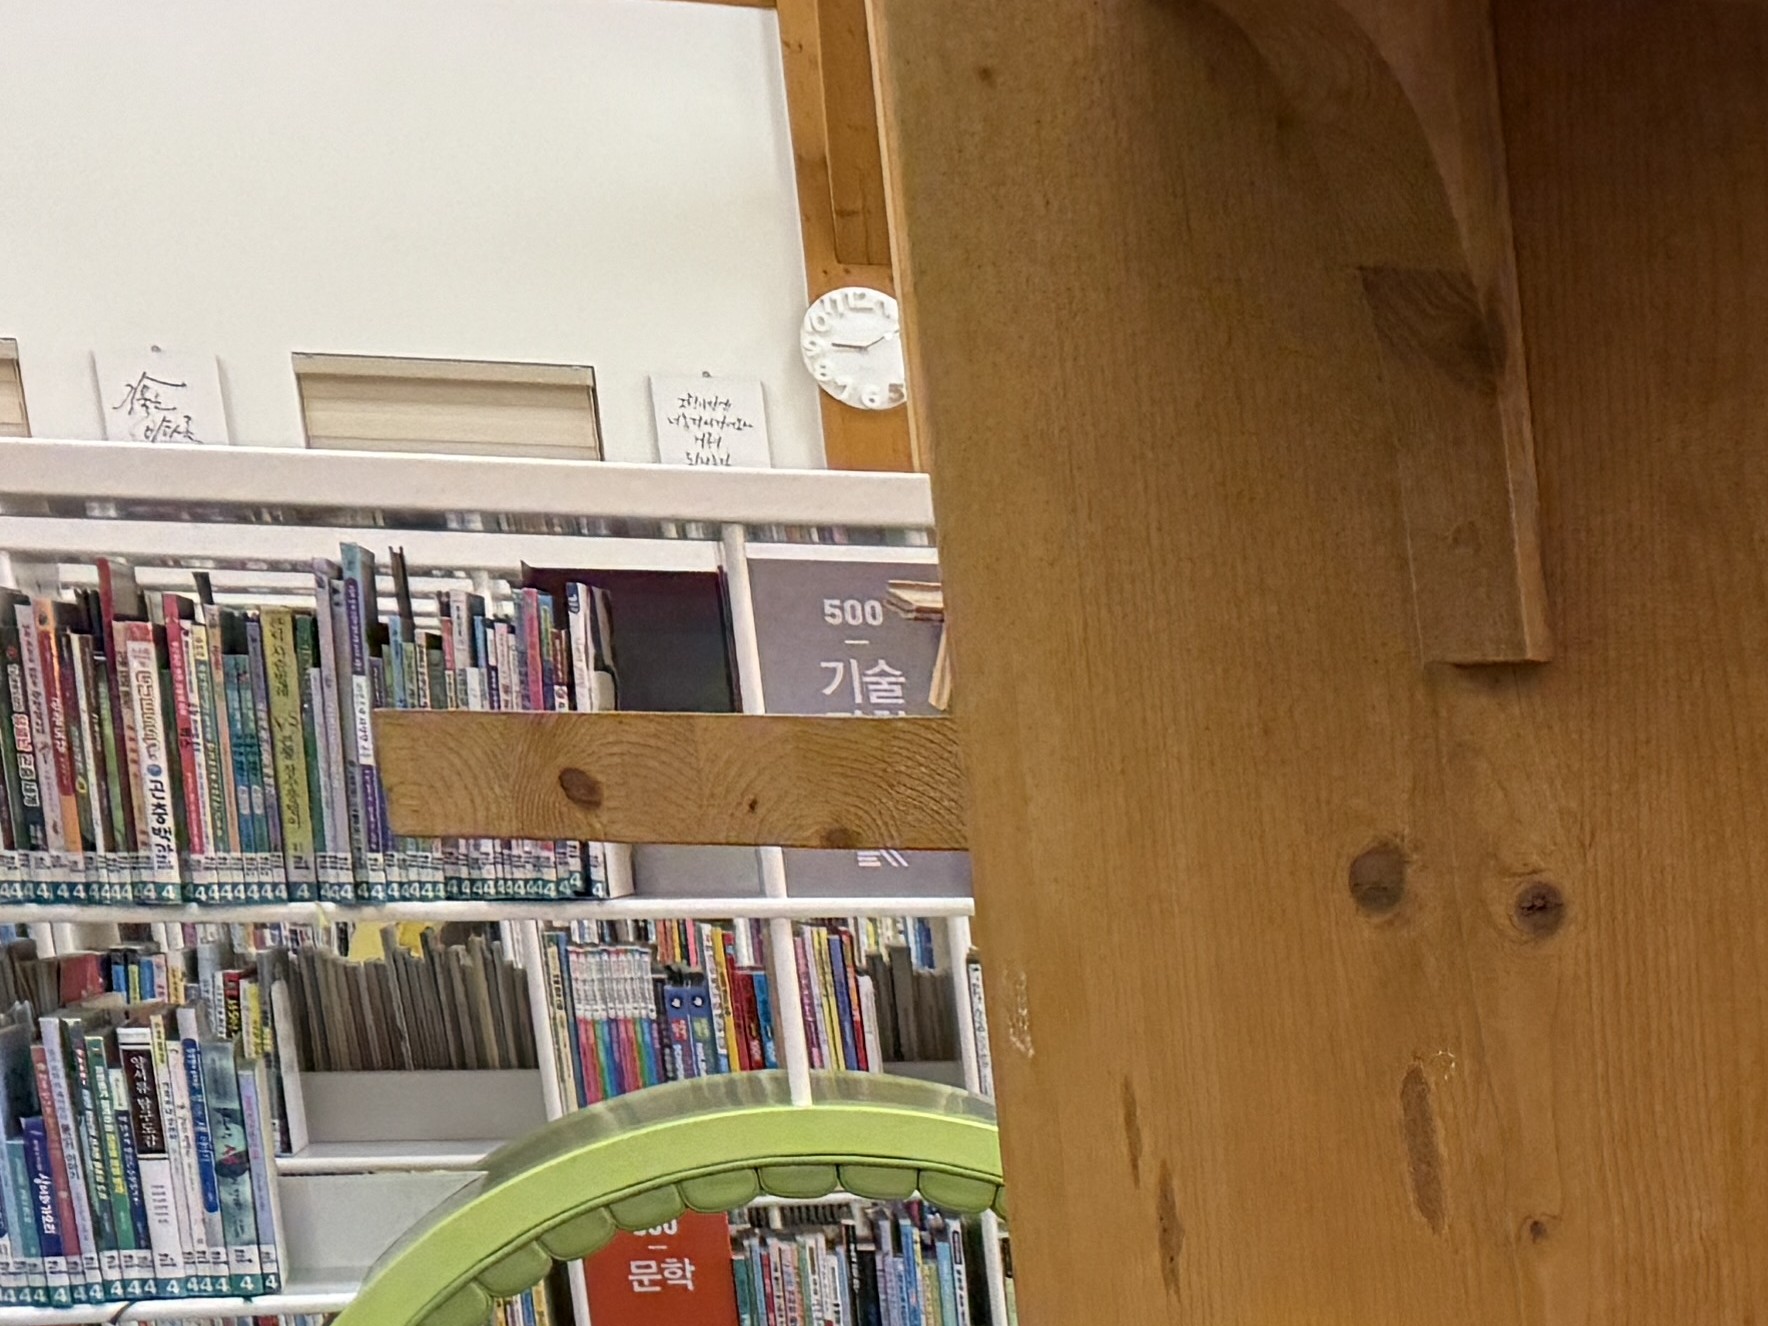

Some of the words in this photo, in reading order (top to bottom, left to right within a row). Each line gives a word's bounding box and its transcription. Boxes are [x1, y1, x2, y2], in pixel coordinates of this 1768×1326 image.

[823, 599, 884, 625] 500
[820, 658, 907, 705] 기술
[628, 1257, 695, 1294] 문학
